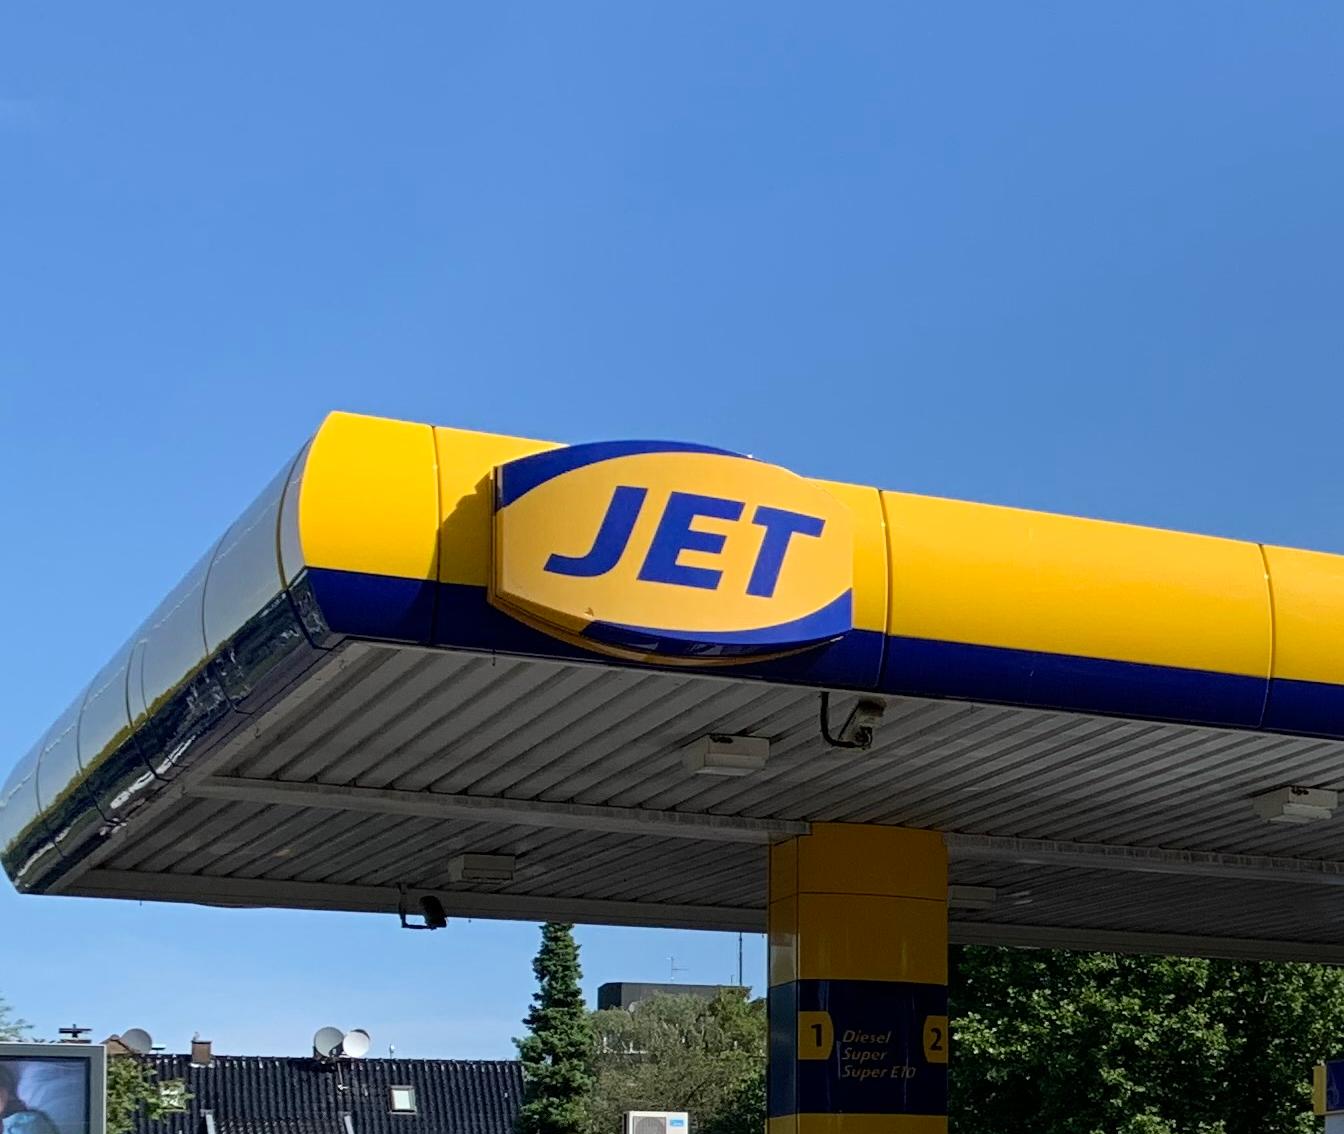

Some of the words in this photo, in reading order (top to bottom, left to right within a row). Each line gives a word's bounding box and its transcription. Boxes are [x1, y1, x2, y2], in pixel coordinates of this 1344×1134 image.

[544, 486, 825, 598] JET
[810, 1023, 822, 1047] 1
[842, 1030, 891, 1044] Diesel
[930, 1027, 942, 1050] 2
[842, 1048, 887, 1063] Super
[842, 1065, 887, 1081] Super
[890, 1066, 916, 1078] E10
